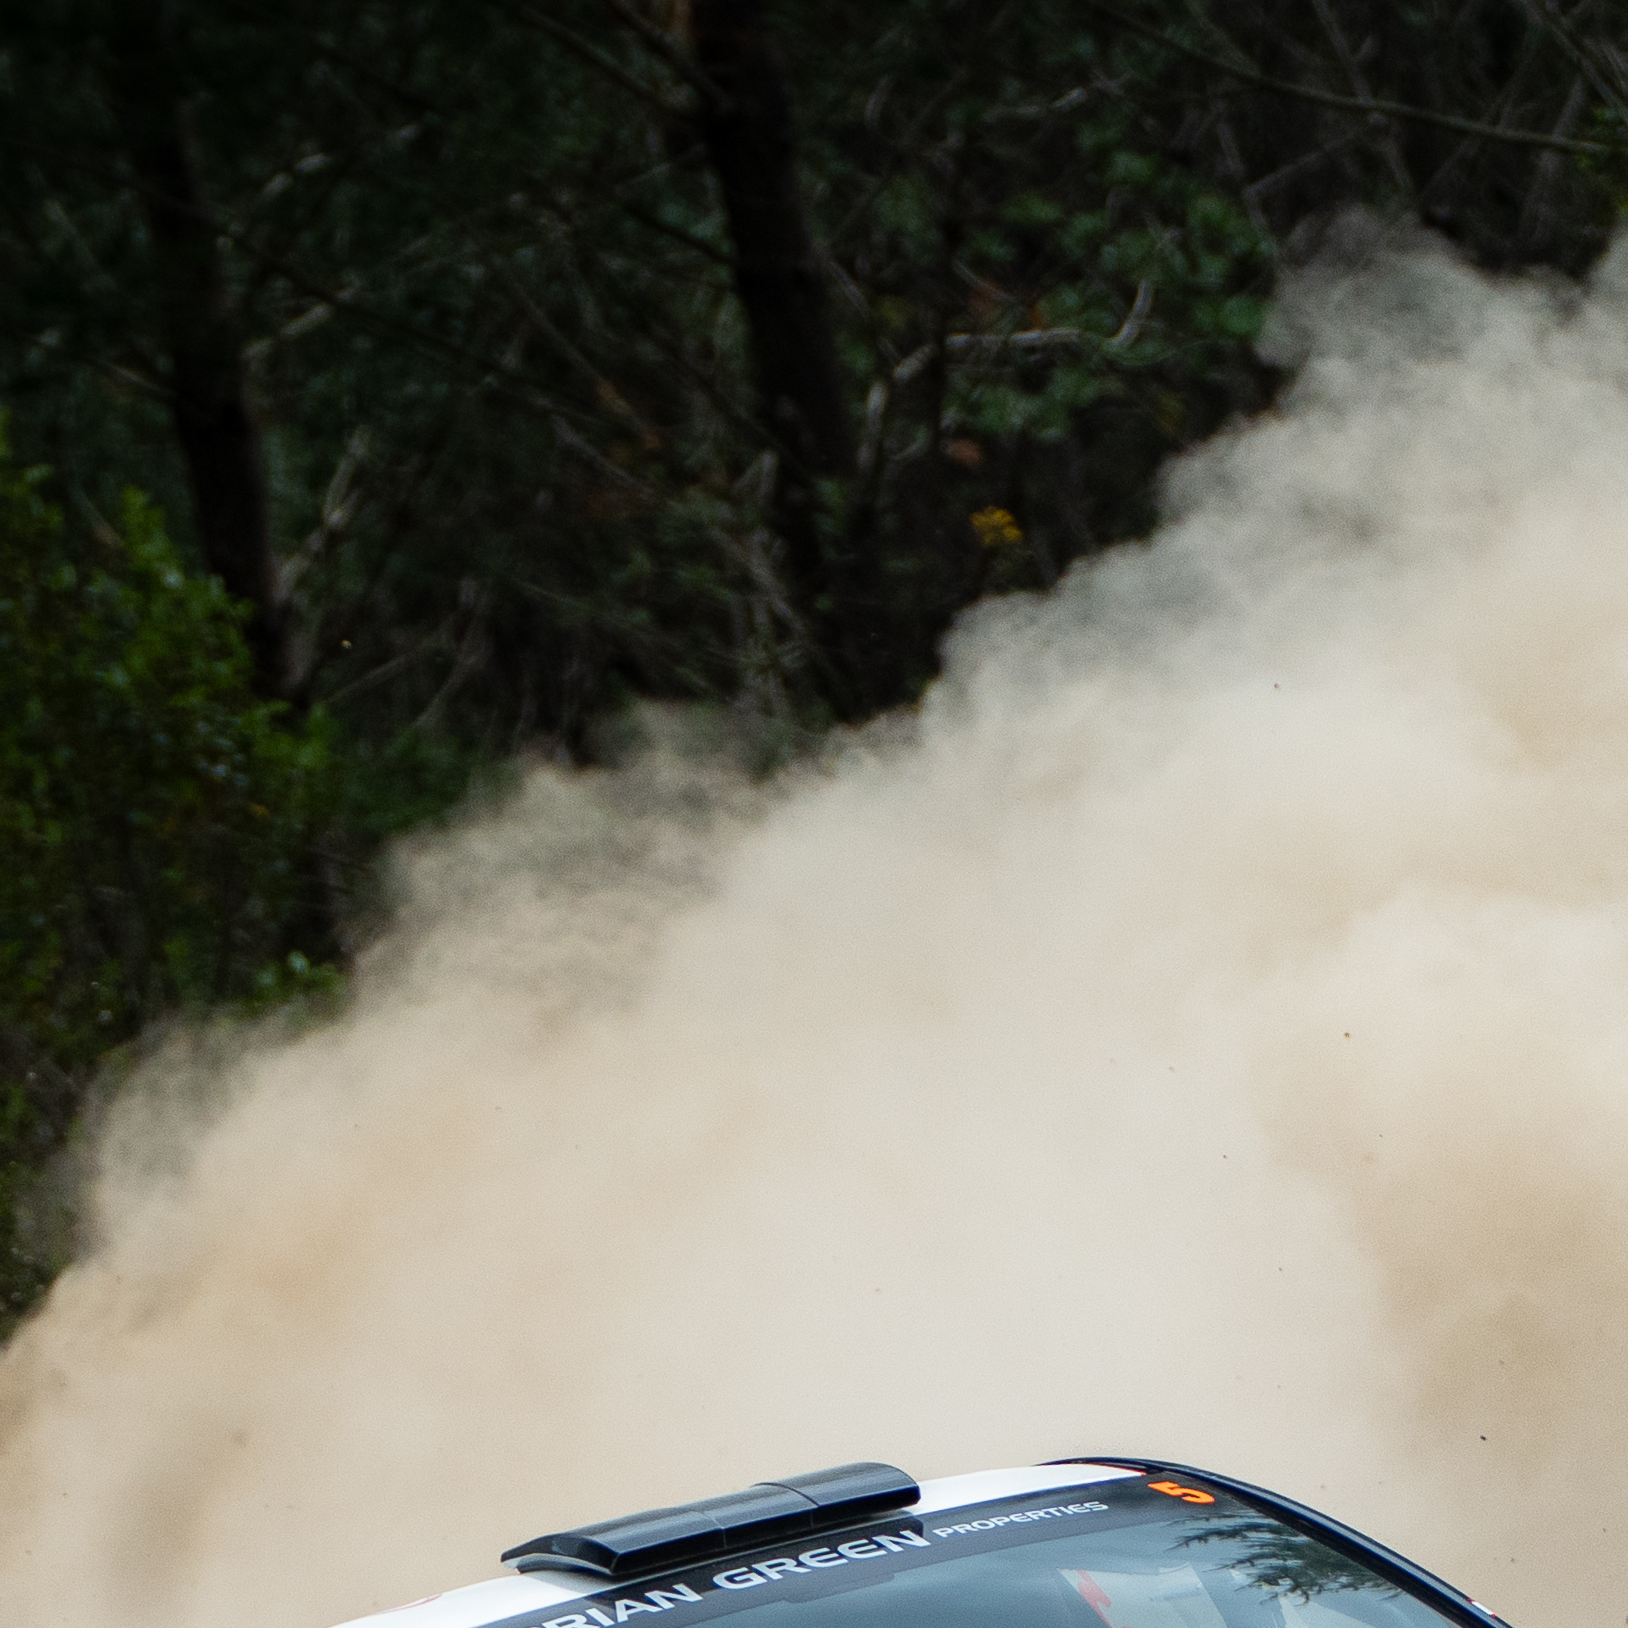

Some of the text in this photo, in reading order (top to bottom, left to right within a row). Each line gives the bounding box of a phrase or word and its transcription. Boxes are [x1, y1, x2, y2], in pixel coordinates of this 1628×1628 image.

[1147, 1481, 1215, 1504] 5
[712, 1529, 931, 1591] GREEN
[932, 1501, 1109, 1528] PROPERTIES
